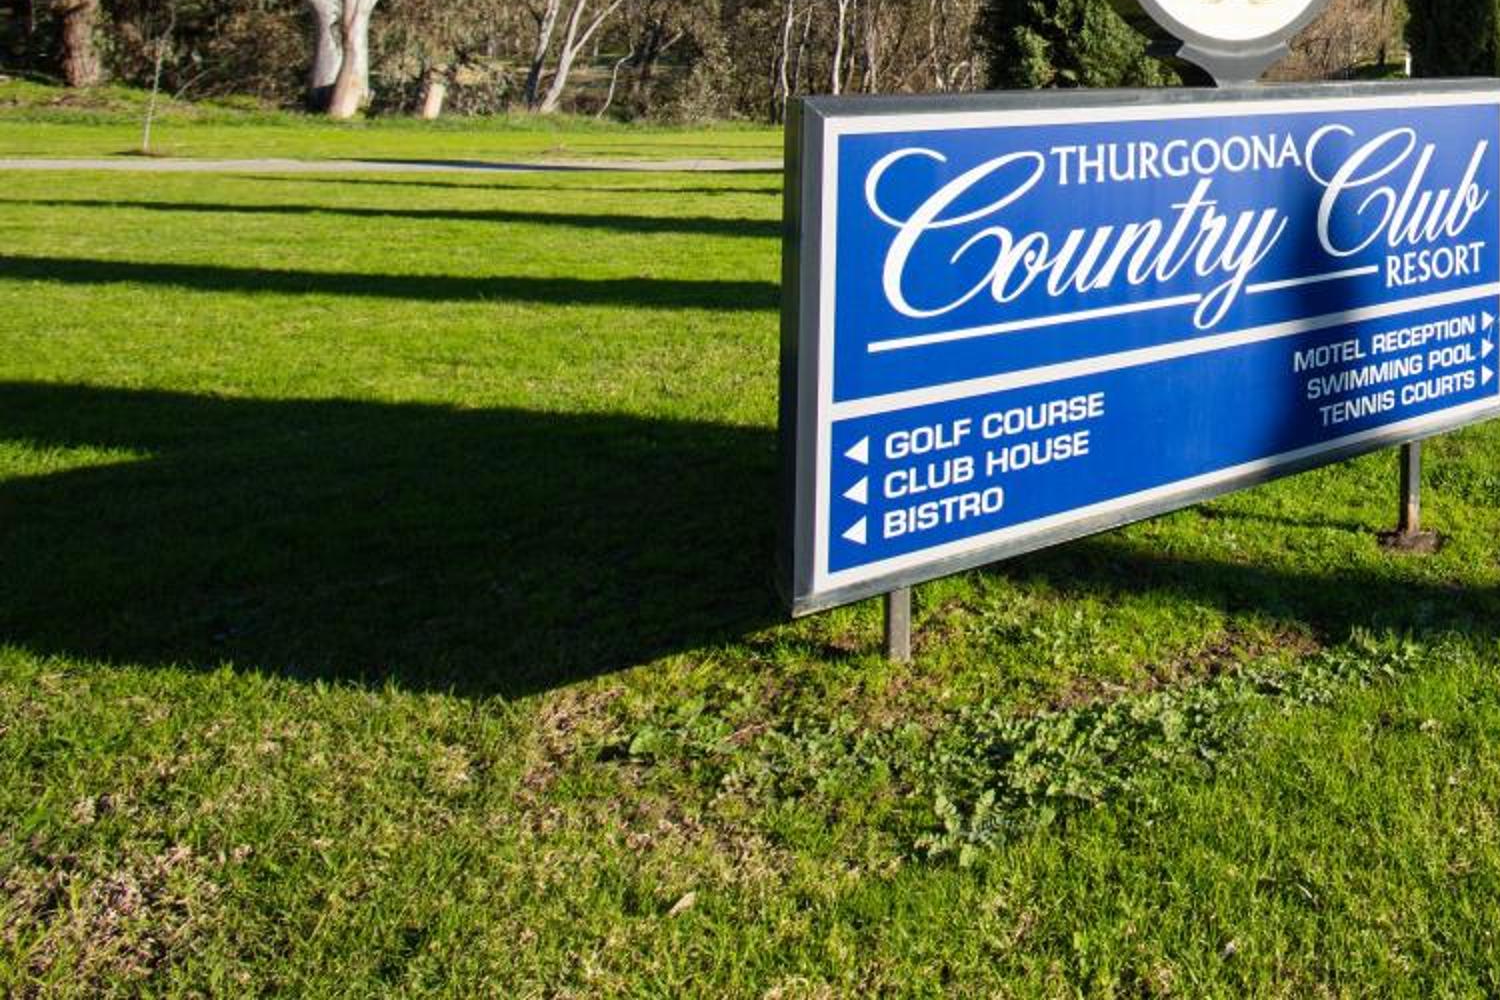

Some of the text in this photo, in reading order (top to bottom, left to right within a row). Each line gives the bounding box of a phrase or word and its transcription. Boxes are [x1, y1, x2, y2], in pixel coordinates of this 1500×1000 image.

[1050, 133, 1302, 186] THURGOONA
[864, 123, 1489, 330] Country Club
[1385, 241, 1485, 288] RESORT
[1293, 314, 1476, 372] MOTEL RECEPTION
[1307, 343, 1477, 399] SWIMMING POOL
[884, 391, 1105, 460] GOLF COURSE
[1319, 369, 1475, 427] TENNIS COURTS
[883, 430, 1090, 499] CLUB HOUSE
[883, 486, 1004, 539] BISTRO
